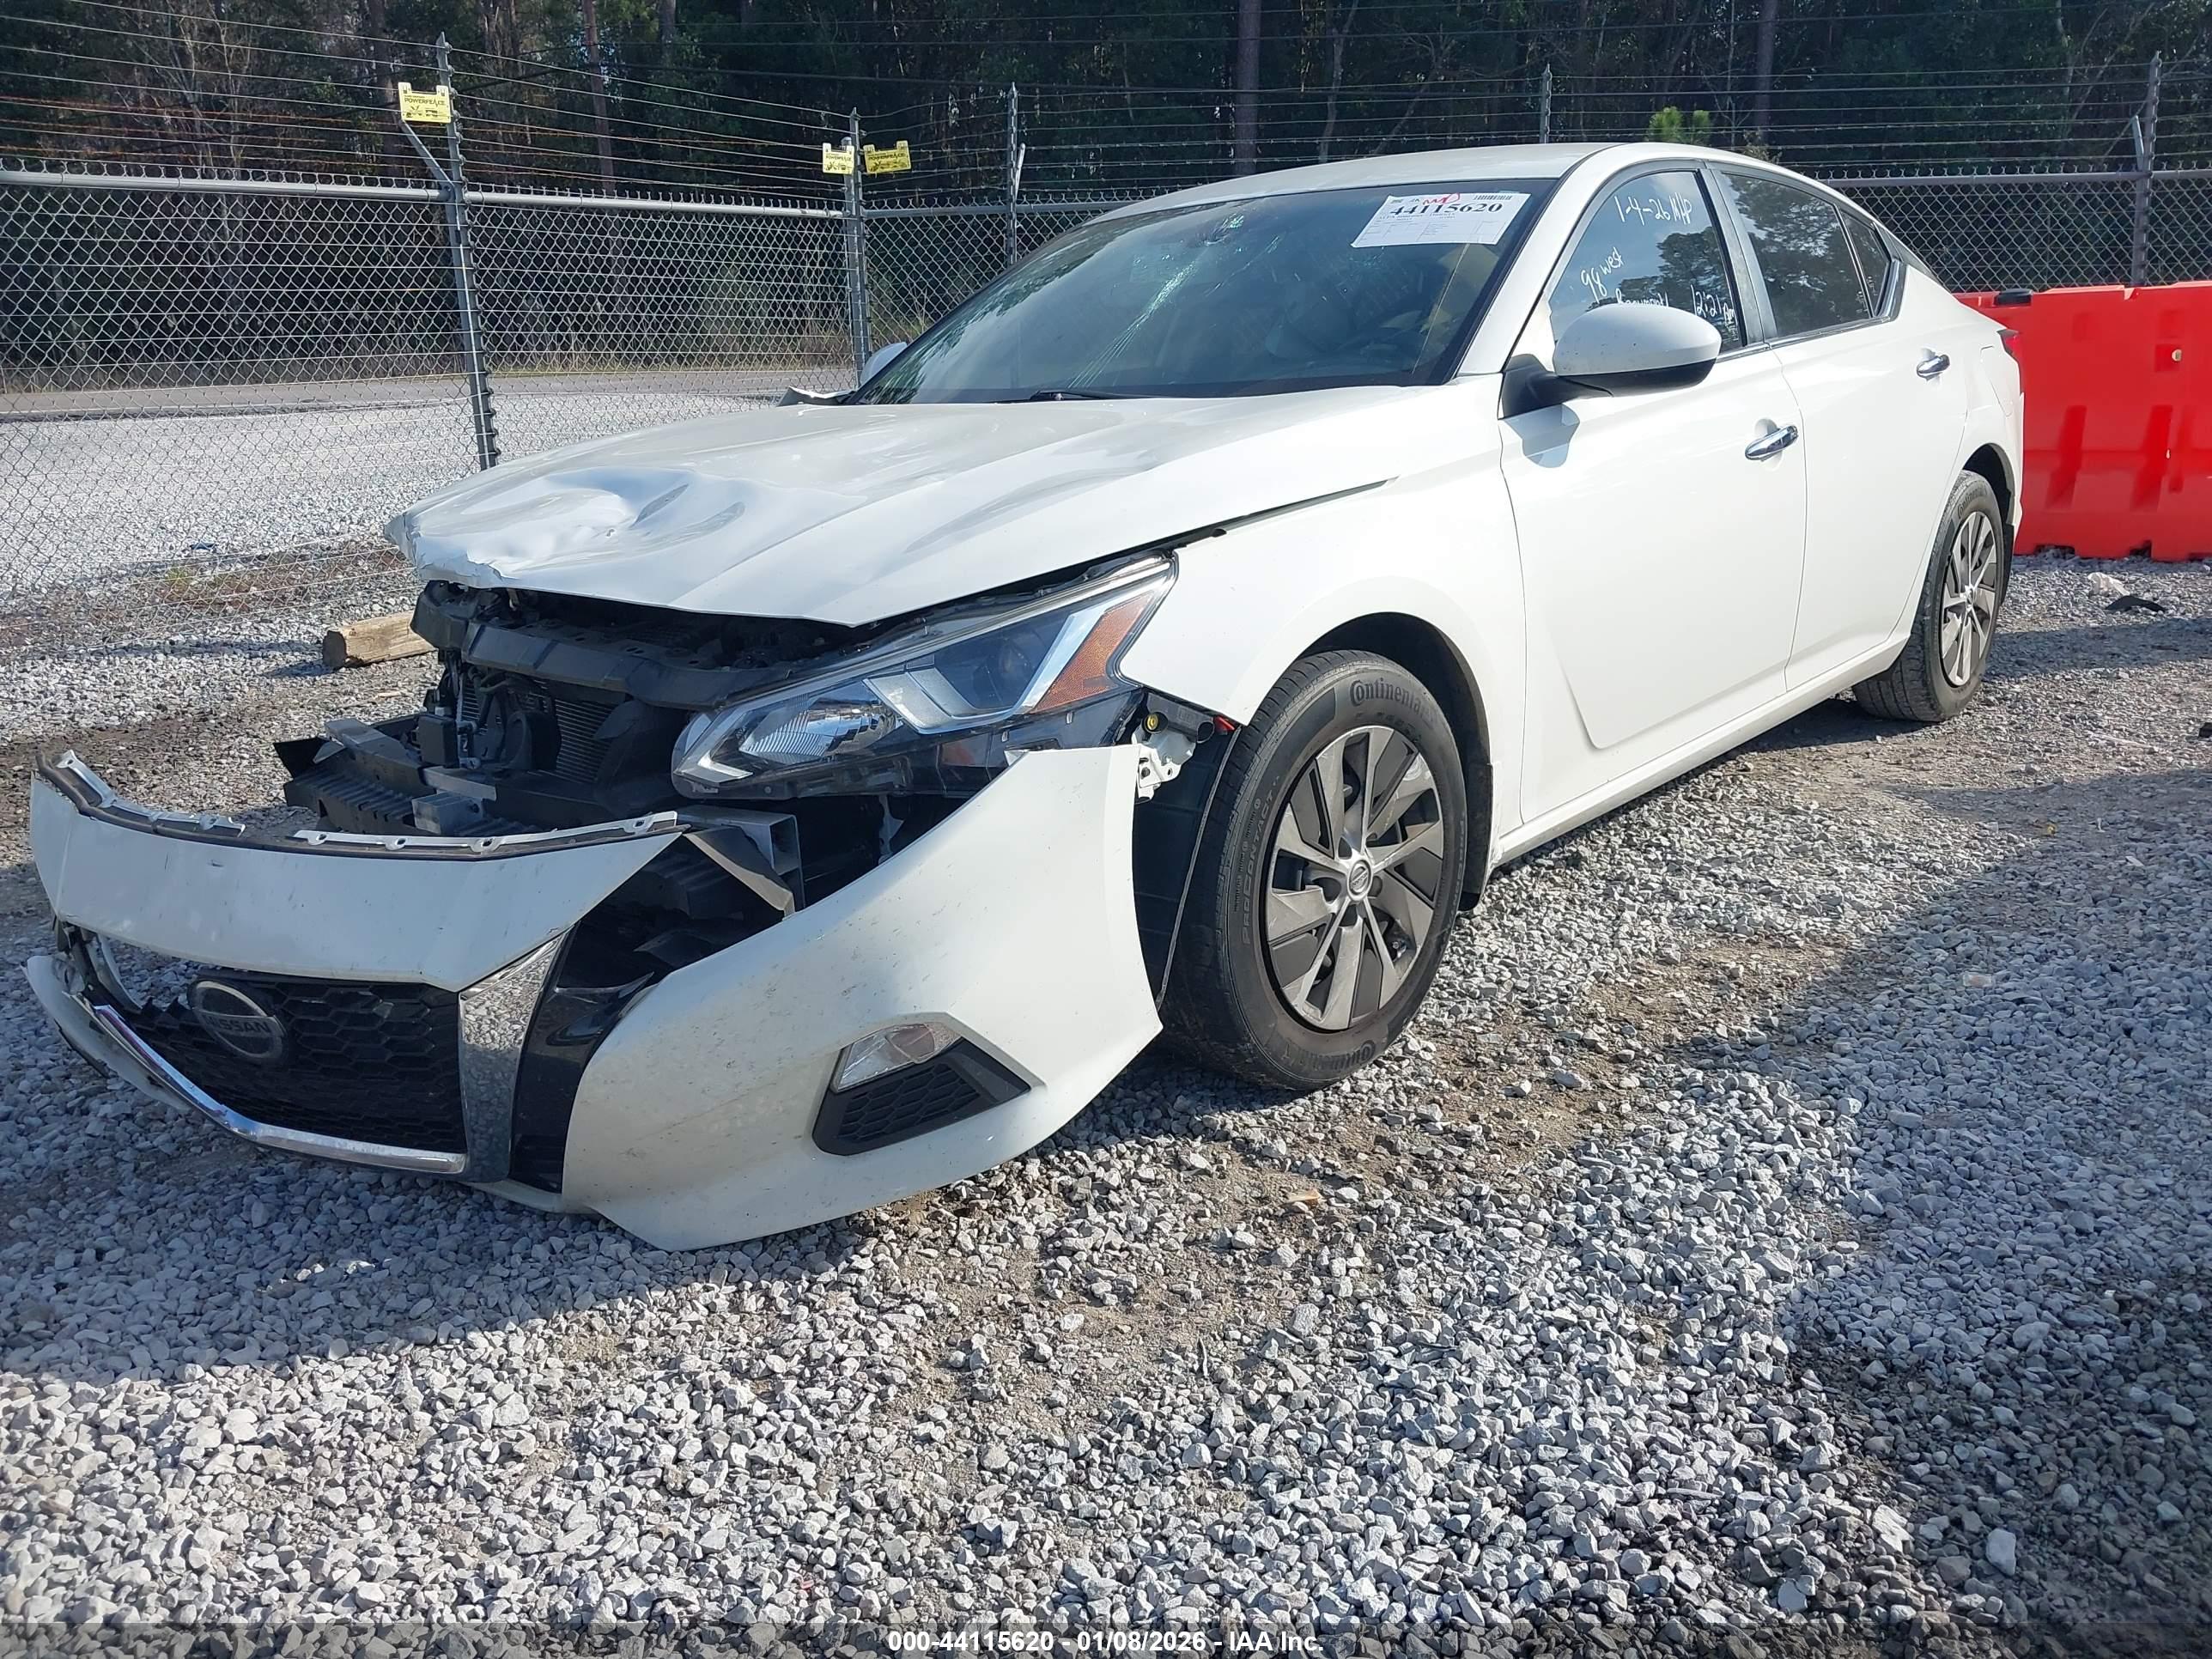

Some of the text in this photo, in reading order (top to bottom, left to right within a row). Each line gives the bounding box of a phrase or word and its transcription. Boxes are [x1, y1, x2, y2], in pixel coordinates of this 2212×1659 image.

[1390, 204, 1503, 215] 44115620
[1614, 196, 1671, 226] 1-4-26
[1581, 267, 1607, 304] 98
